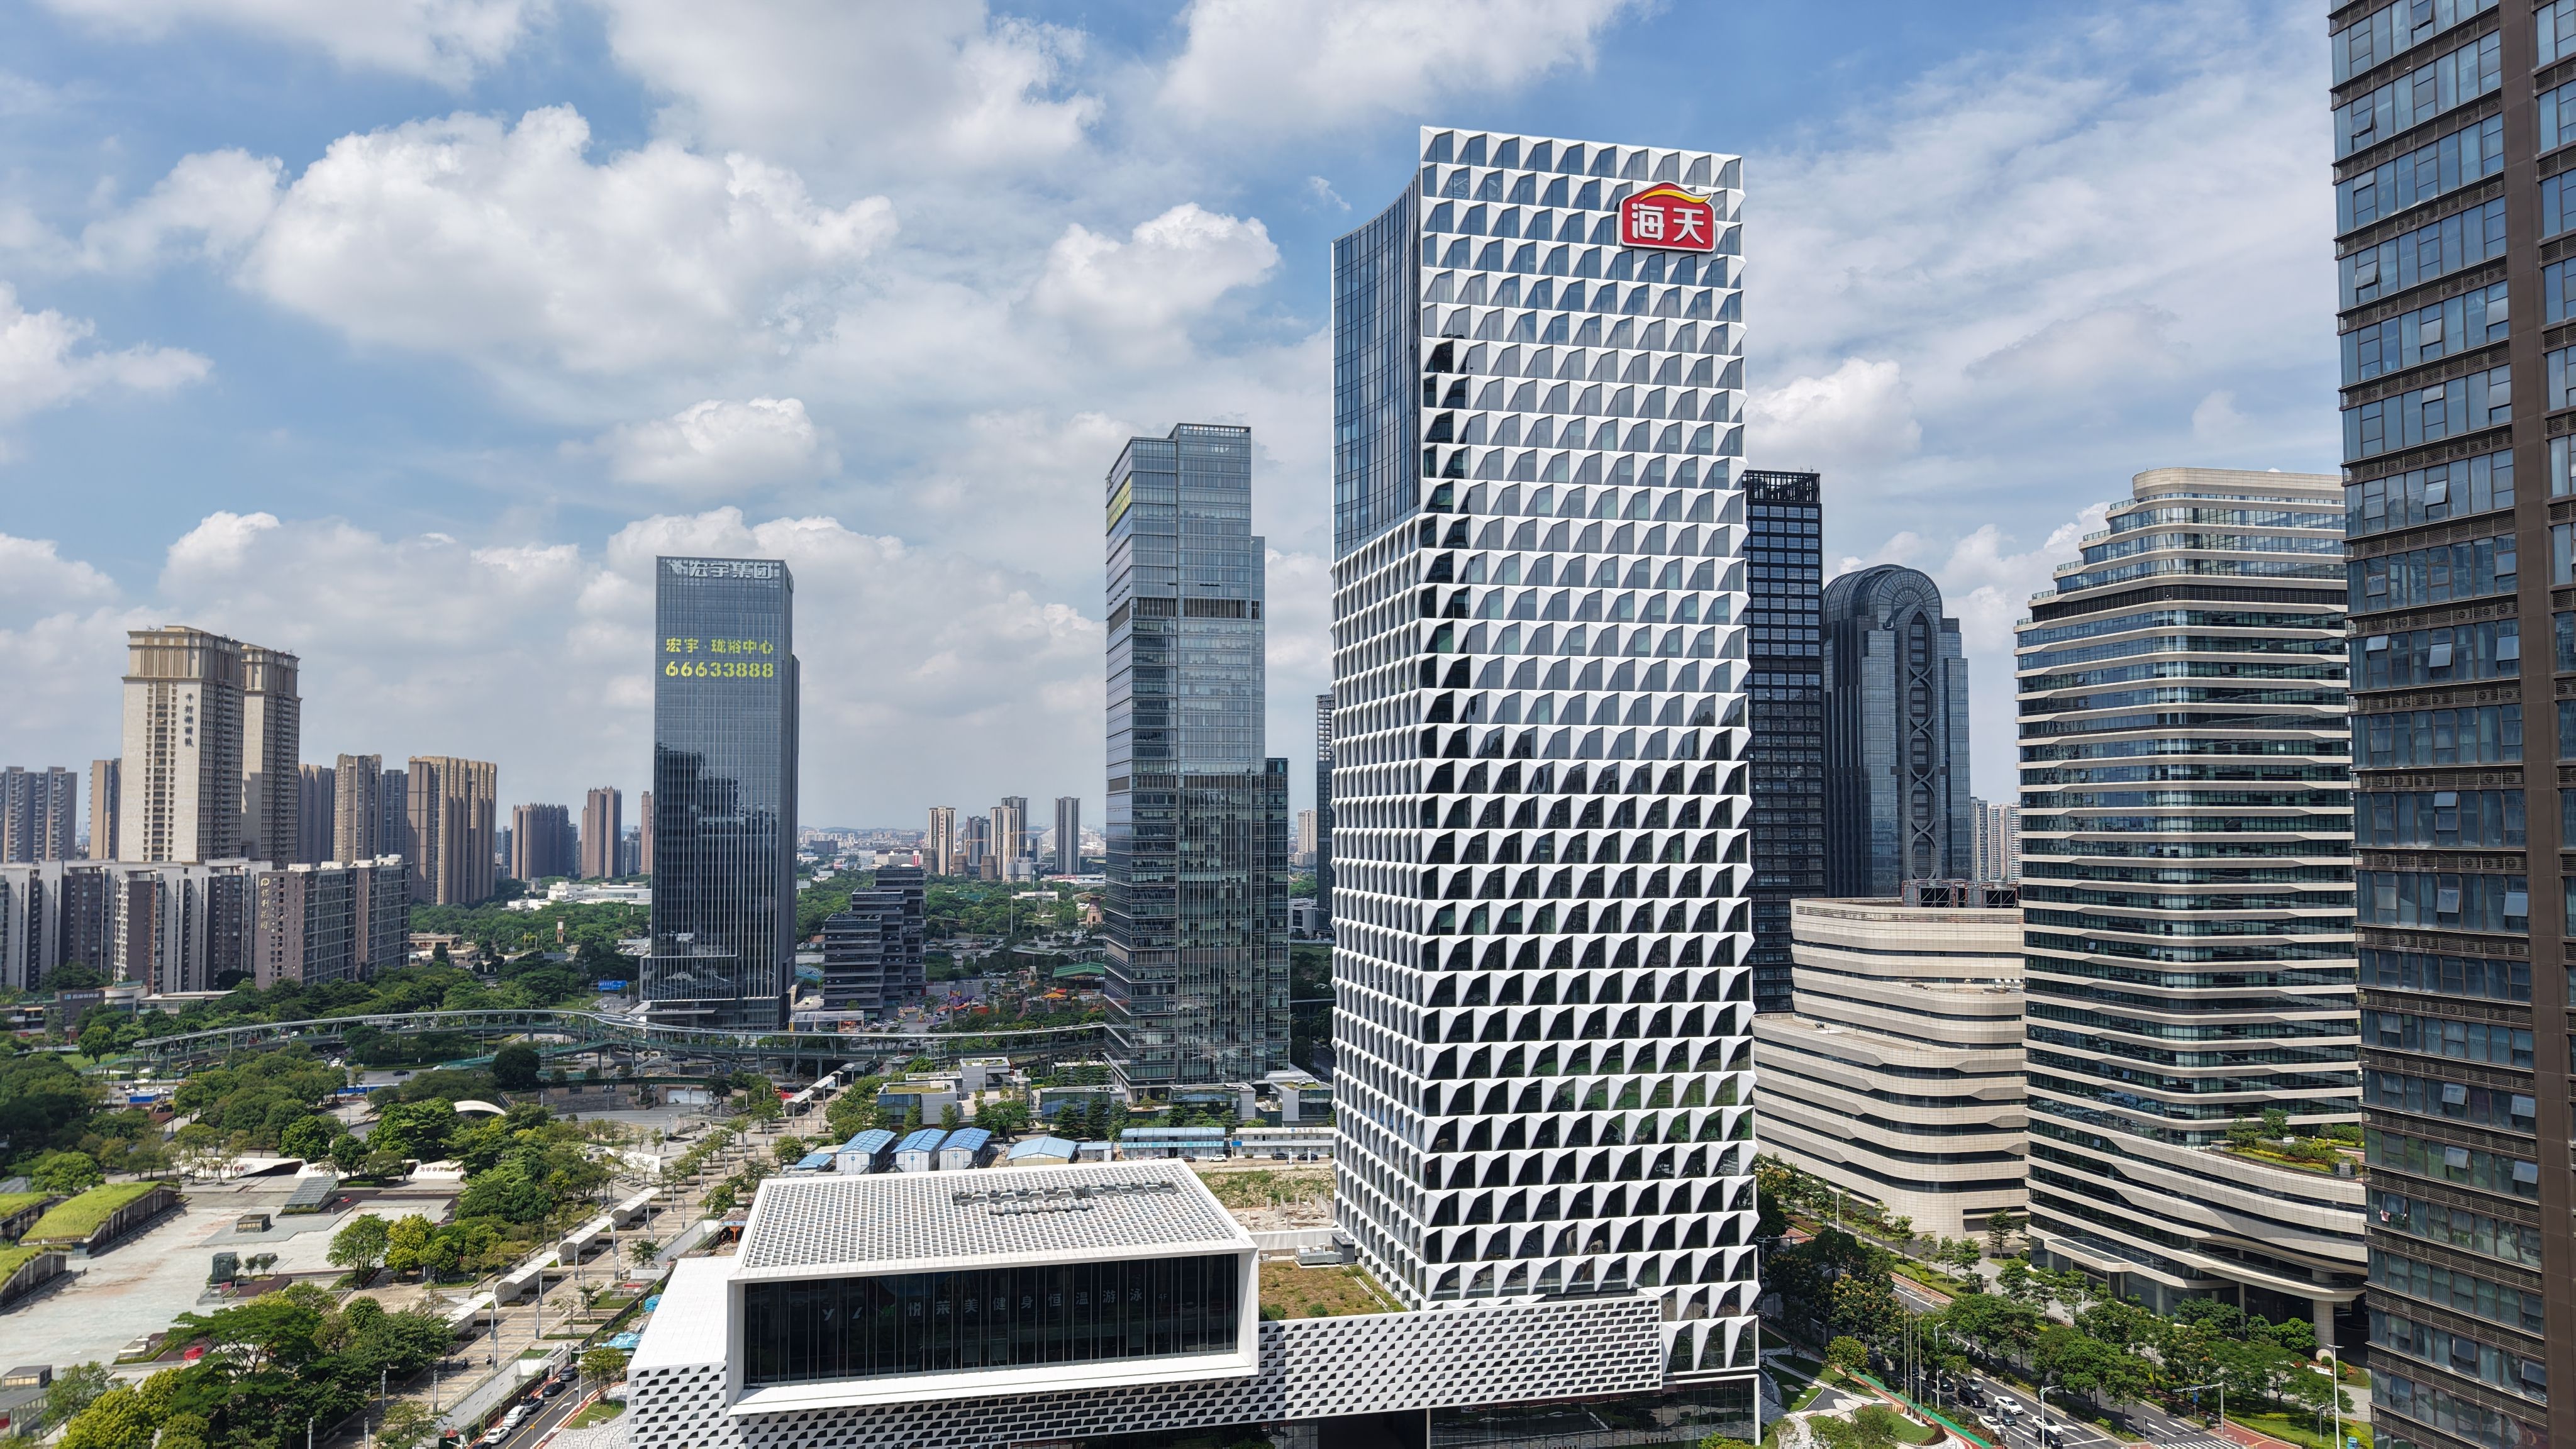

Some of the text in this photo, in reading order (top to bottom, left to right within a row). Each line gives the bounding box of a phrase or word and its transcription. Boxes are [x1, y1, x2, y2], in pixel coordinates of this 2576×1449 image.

[1631, 203, 1704, 244] 海天
[689, 560, 772, 579] 宏宇集团
[665, 661, 774, 678] 66633888
